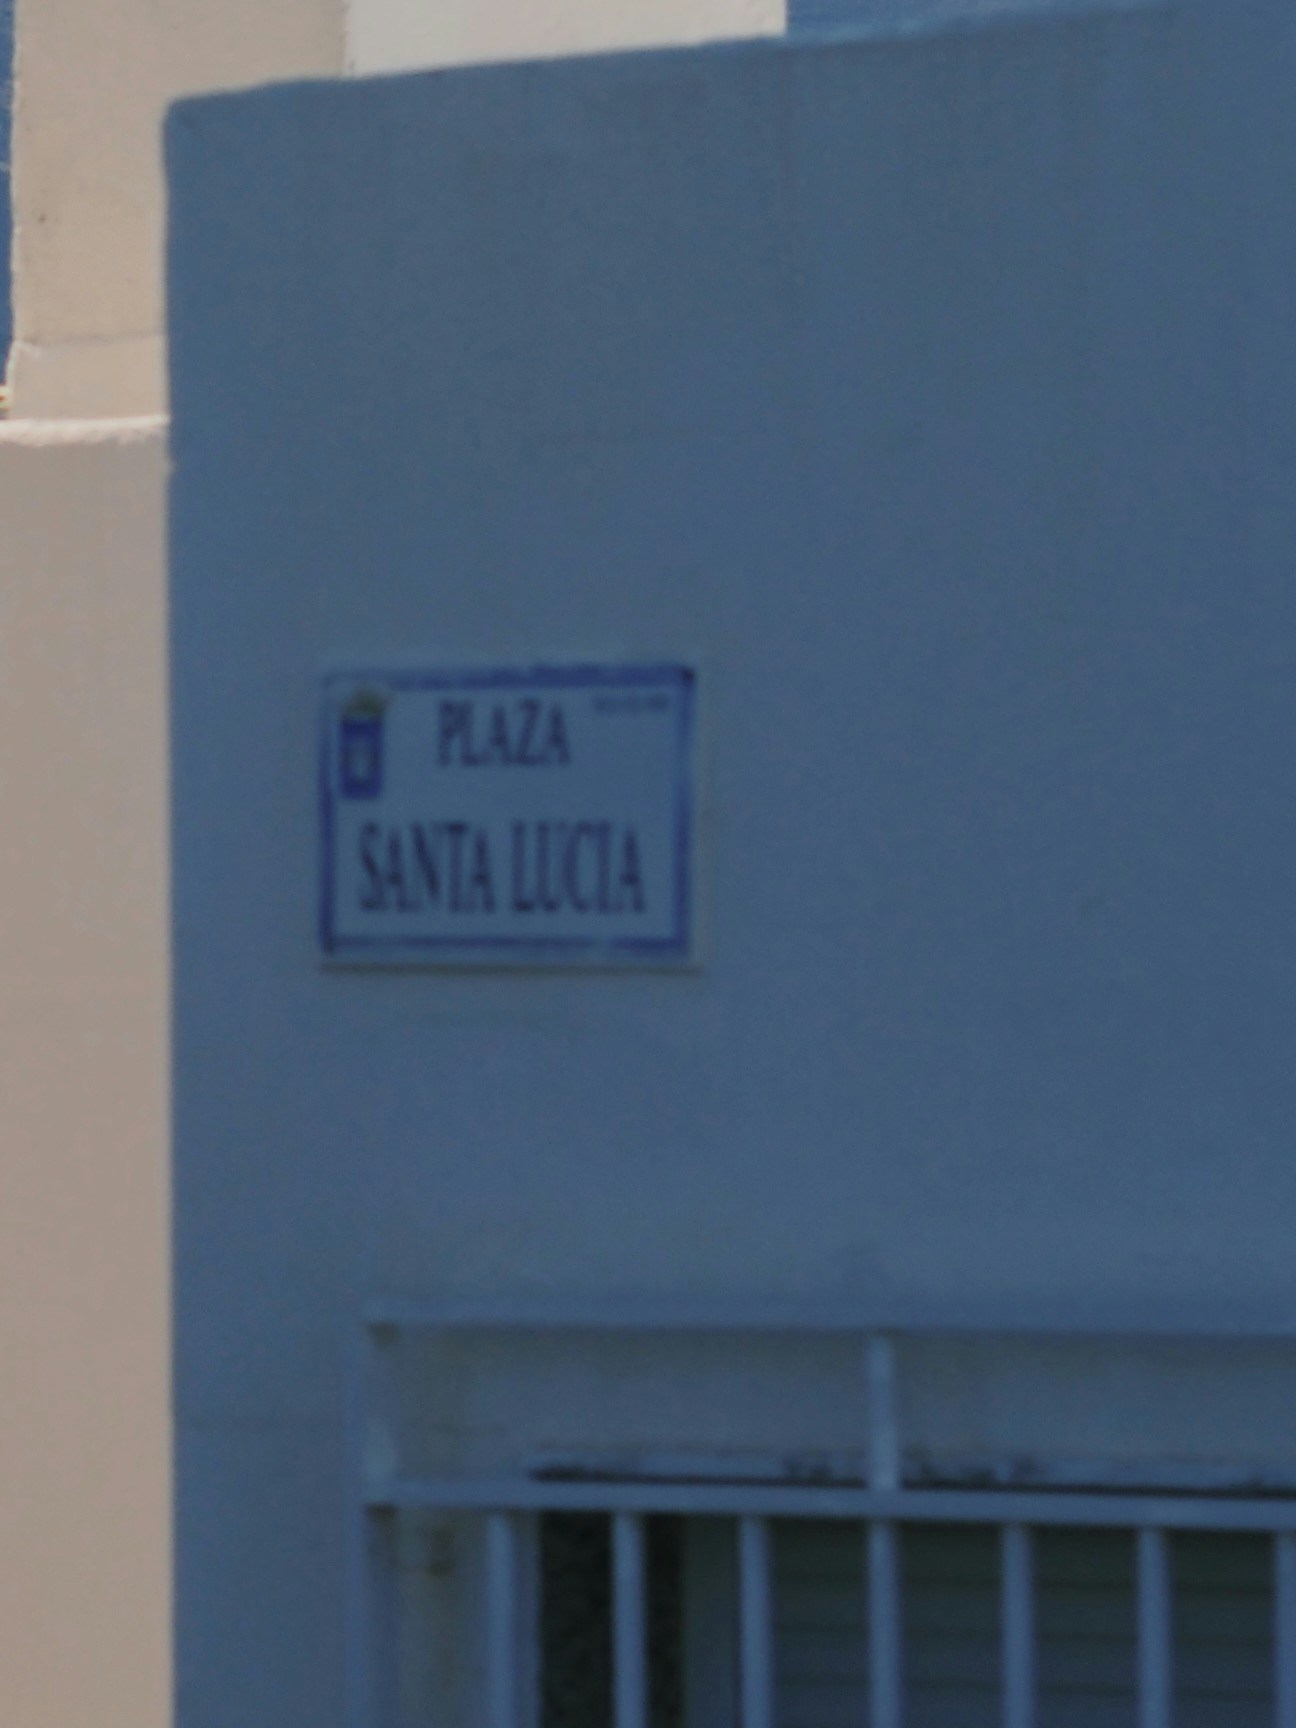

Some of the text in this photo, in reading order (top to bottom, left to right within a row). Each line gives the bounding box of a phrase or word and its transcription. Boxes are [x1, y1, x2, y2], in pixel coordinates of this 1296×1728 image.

[437, 699, 571, 766] PLAZA
[359, 820, 646, 914] SANTA LUCIA
